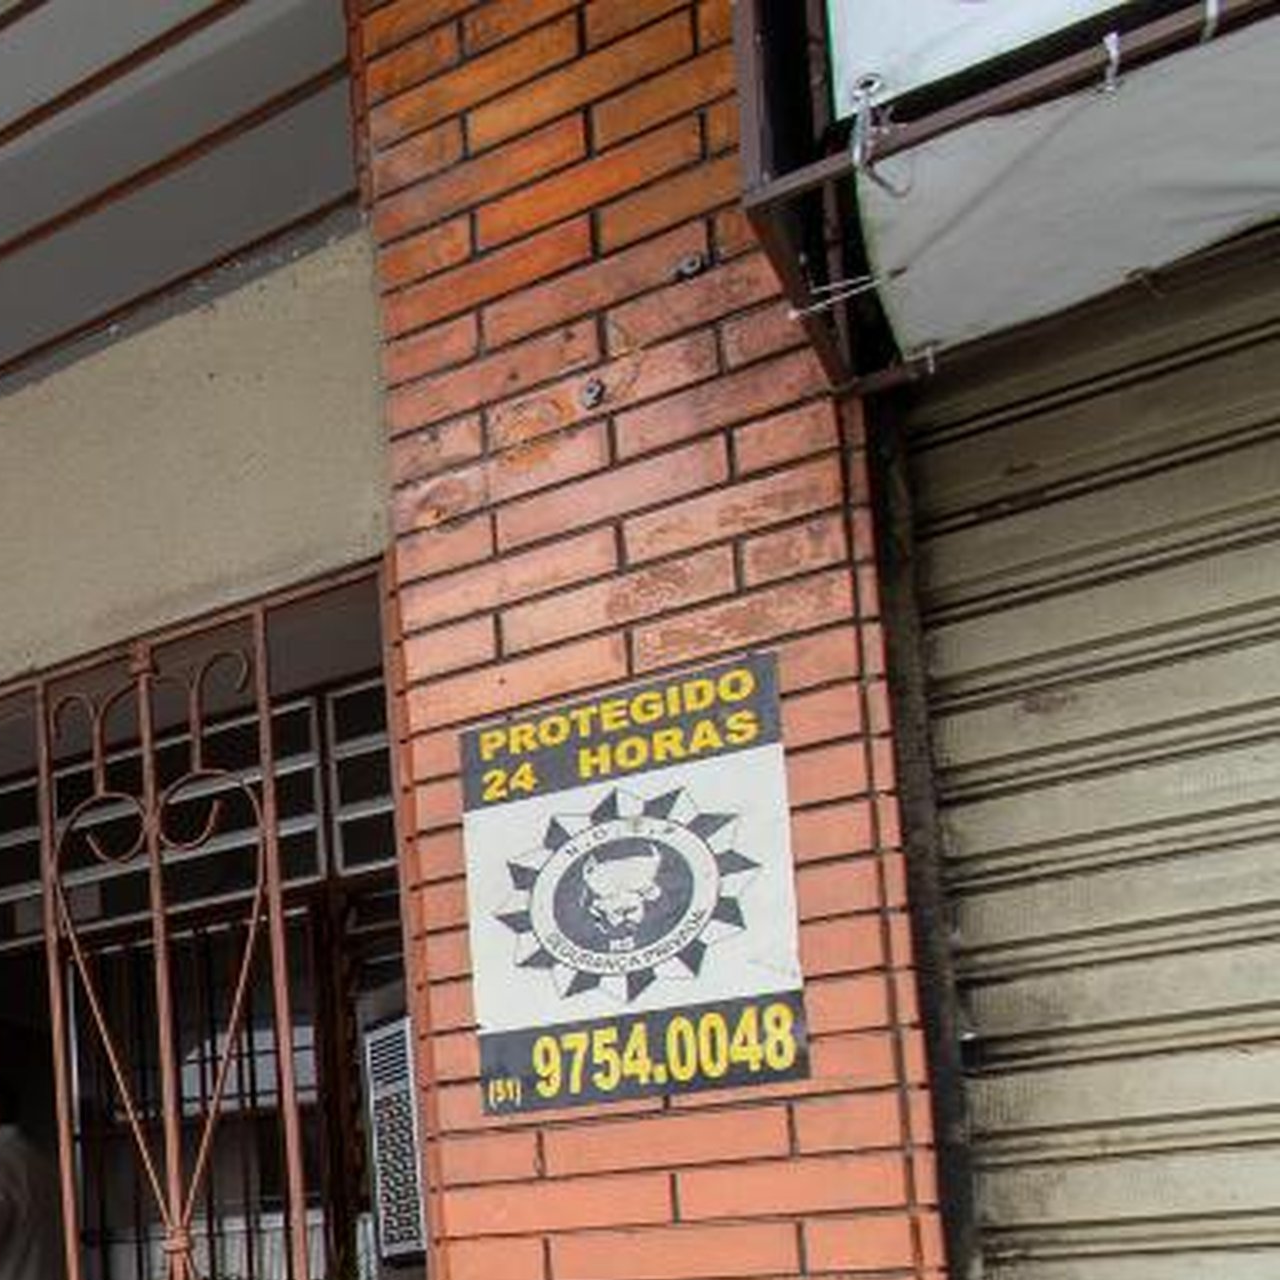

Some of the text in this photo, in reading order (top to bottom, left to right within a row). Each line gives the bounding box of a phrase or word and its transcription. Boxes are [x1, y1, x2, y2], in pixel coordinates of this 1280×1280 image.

[479, 668, 756, 761] PROTEGIDO
[482, 709, 759, 802] 24 HORAS
[532, 1002, 798, 1098] 9754.0048
